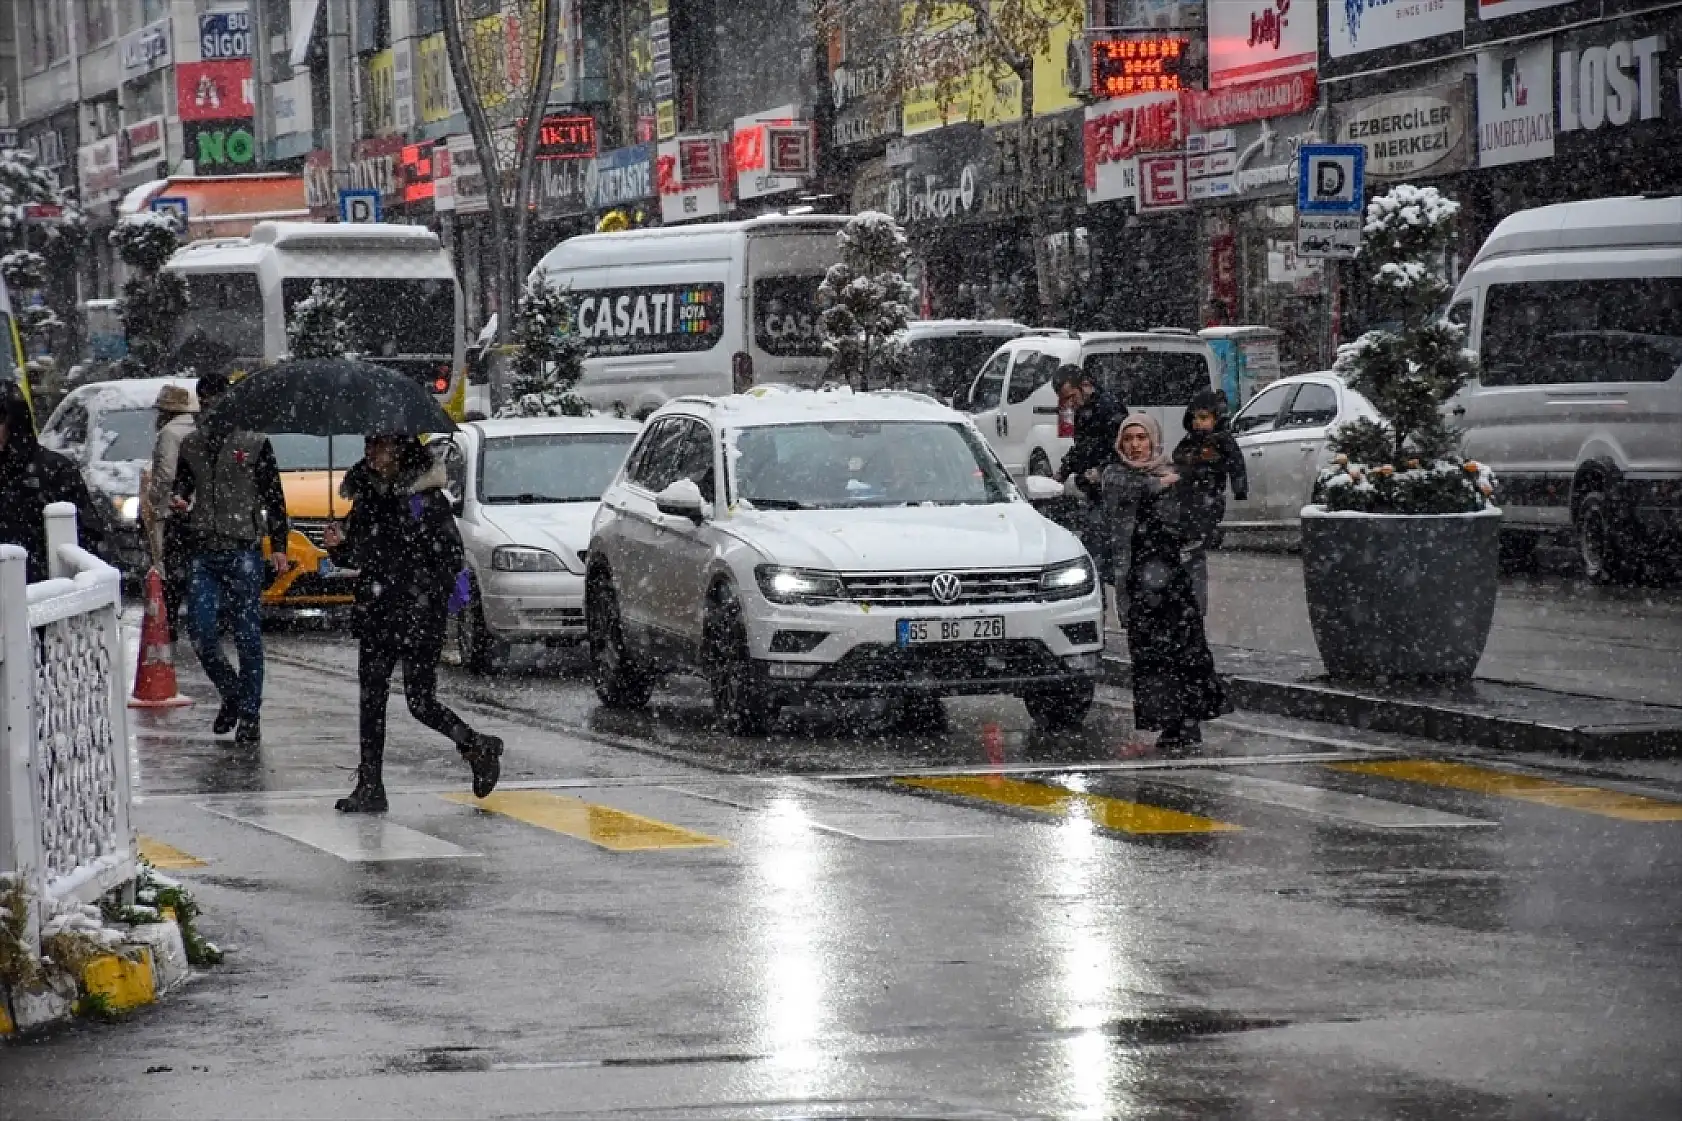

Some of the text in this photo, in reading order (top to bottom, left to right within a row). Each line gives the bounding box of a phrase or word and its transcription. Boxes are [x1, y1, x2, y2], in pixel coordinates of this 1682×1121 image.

[1560, 36, 1666, 131] LOST
[1349, 105, 1452, 139] EZBERCİLER
[1479, 112, 1554, 151] LUMBERJACK
[1374, 126, 1449, 159] MERKEZİ
[1151, 161, 1178, 200] E
[1317, 161, 1345, 196] D
[578, 293, 674, 338] CASATI
[910, 620, 1001, 640] 65 BG 226
